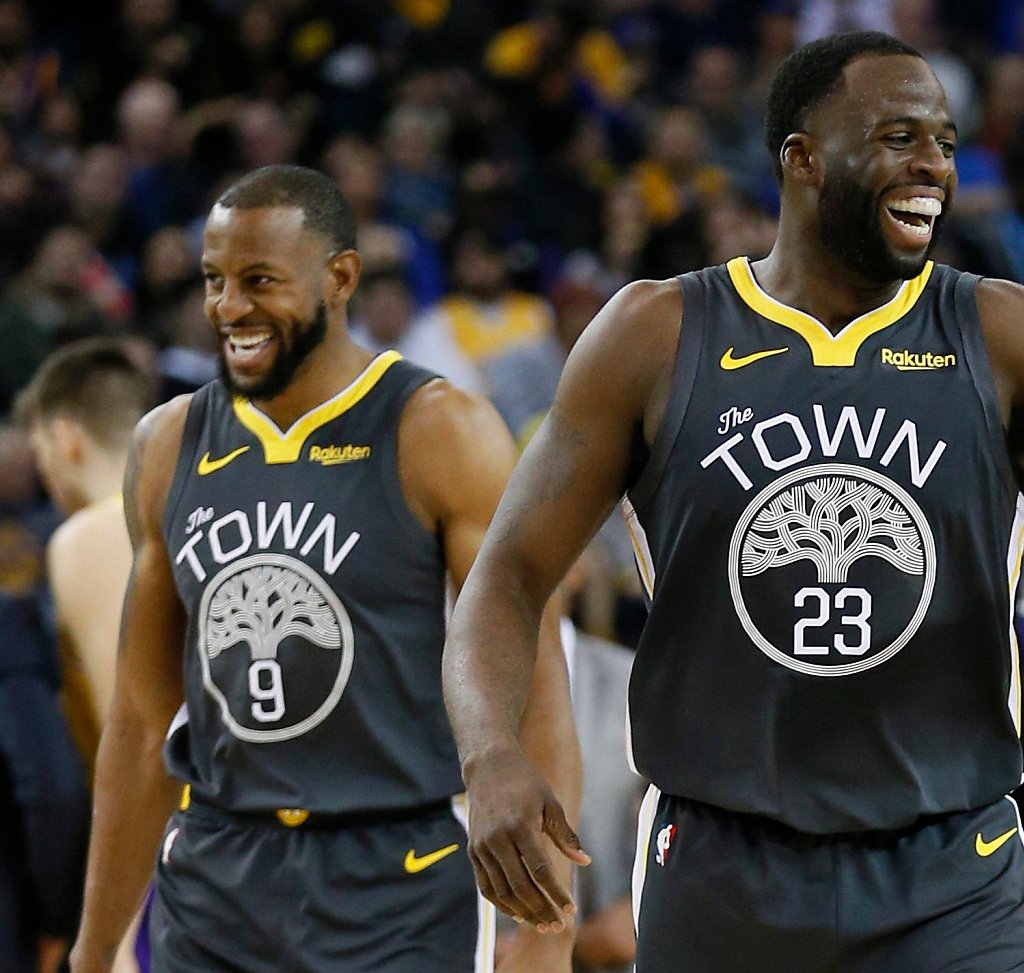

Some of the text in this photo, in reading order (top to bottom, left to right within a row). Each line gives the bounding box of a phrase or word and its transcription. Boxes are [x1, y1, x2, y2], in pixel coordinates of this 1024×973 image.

[882, 348, 956, 368] Rakuten
[717, 406, 754, 434] The
[309, 445, 371, 463] Rakuten
[700, 404, 948, 491] TOWN
[176, 501, 361, 582] TOWN
[185, 506, 214, 534] The
[793, 587, 872, 655] 23
[249, 660, 286, 722] 9
